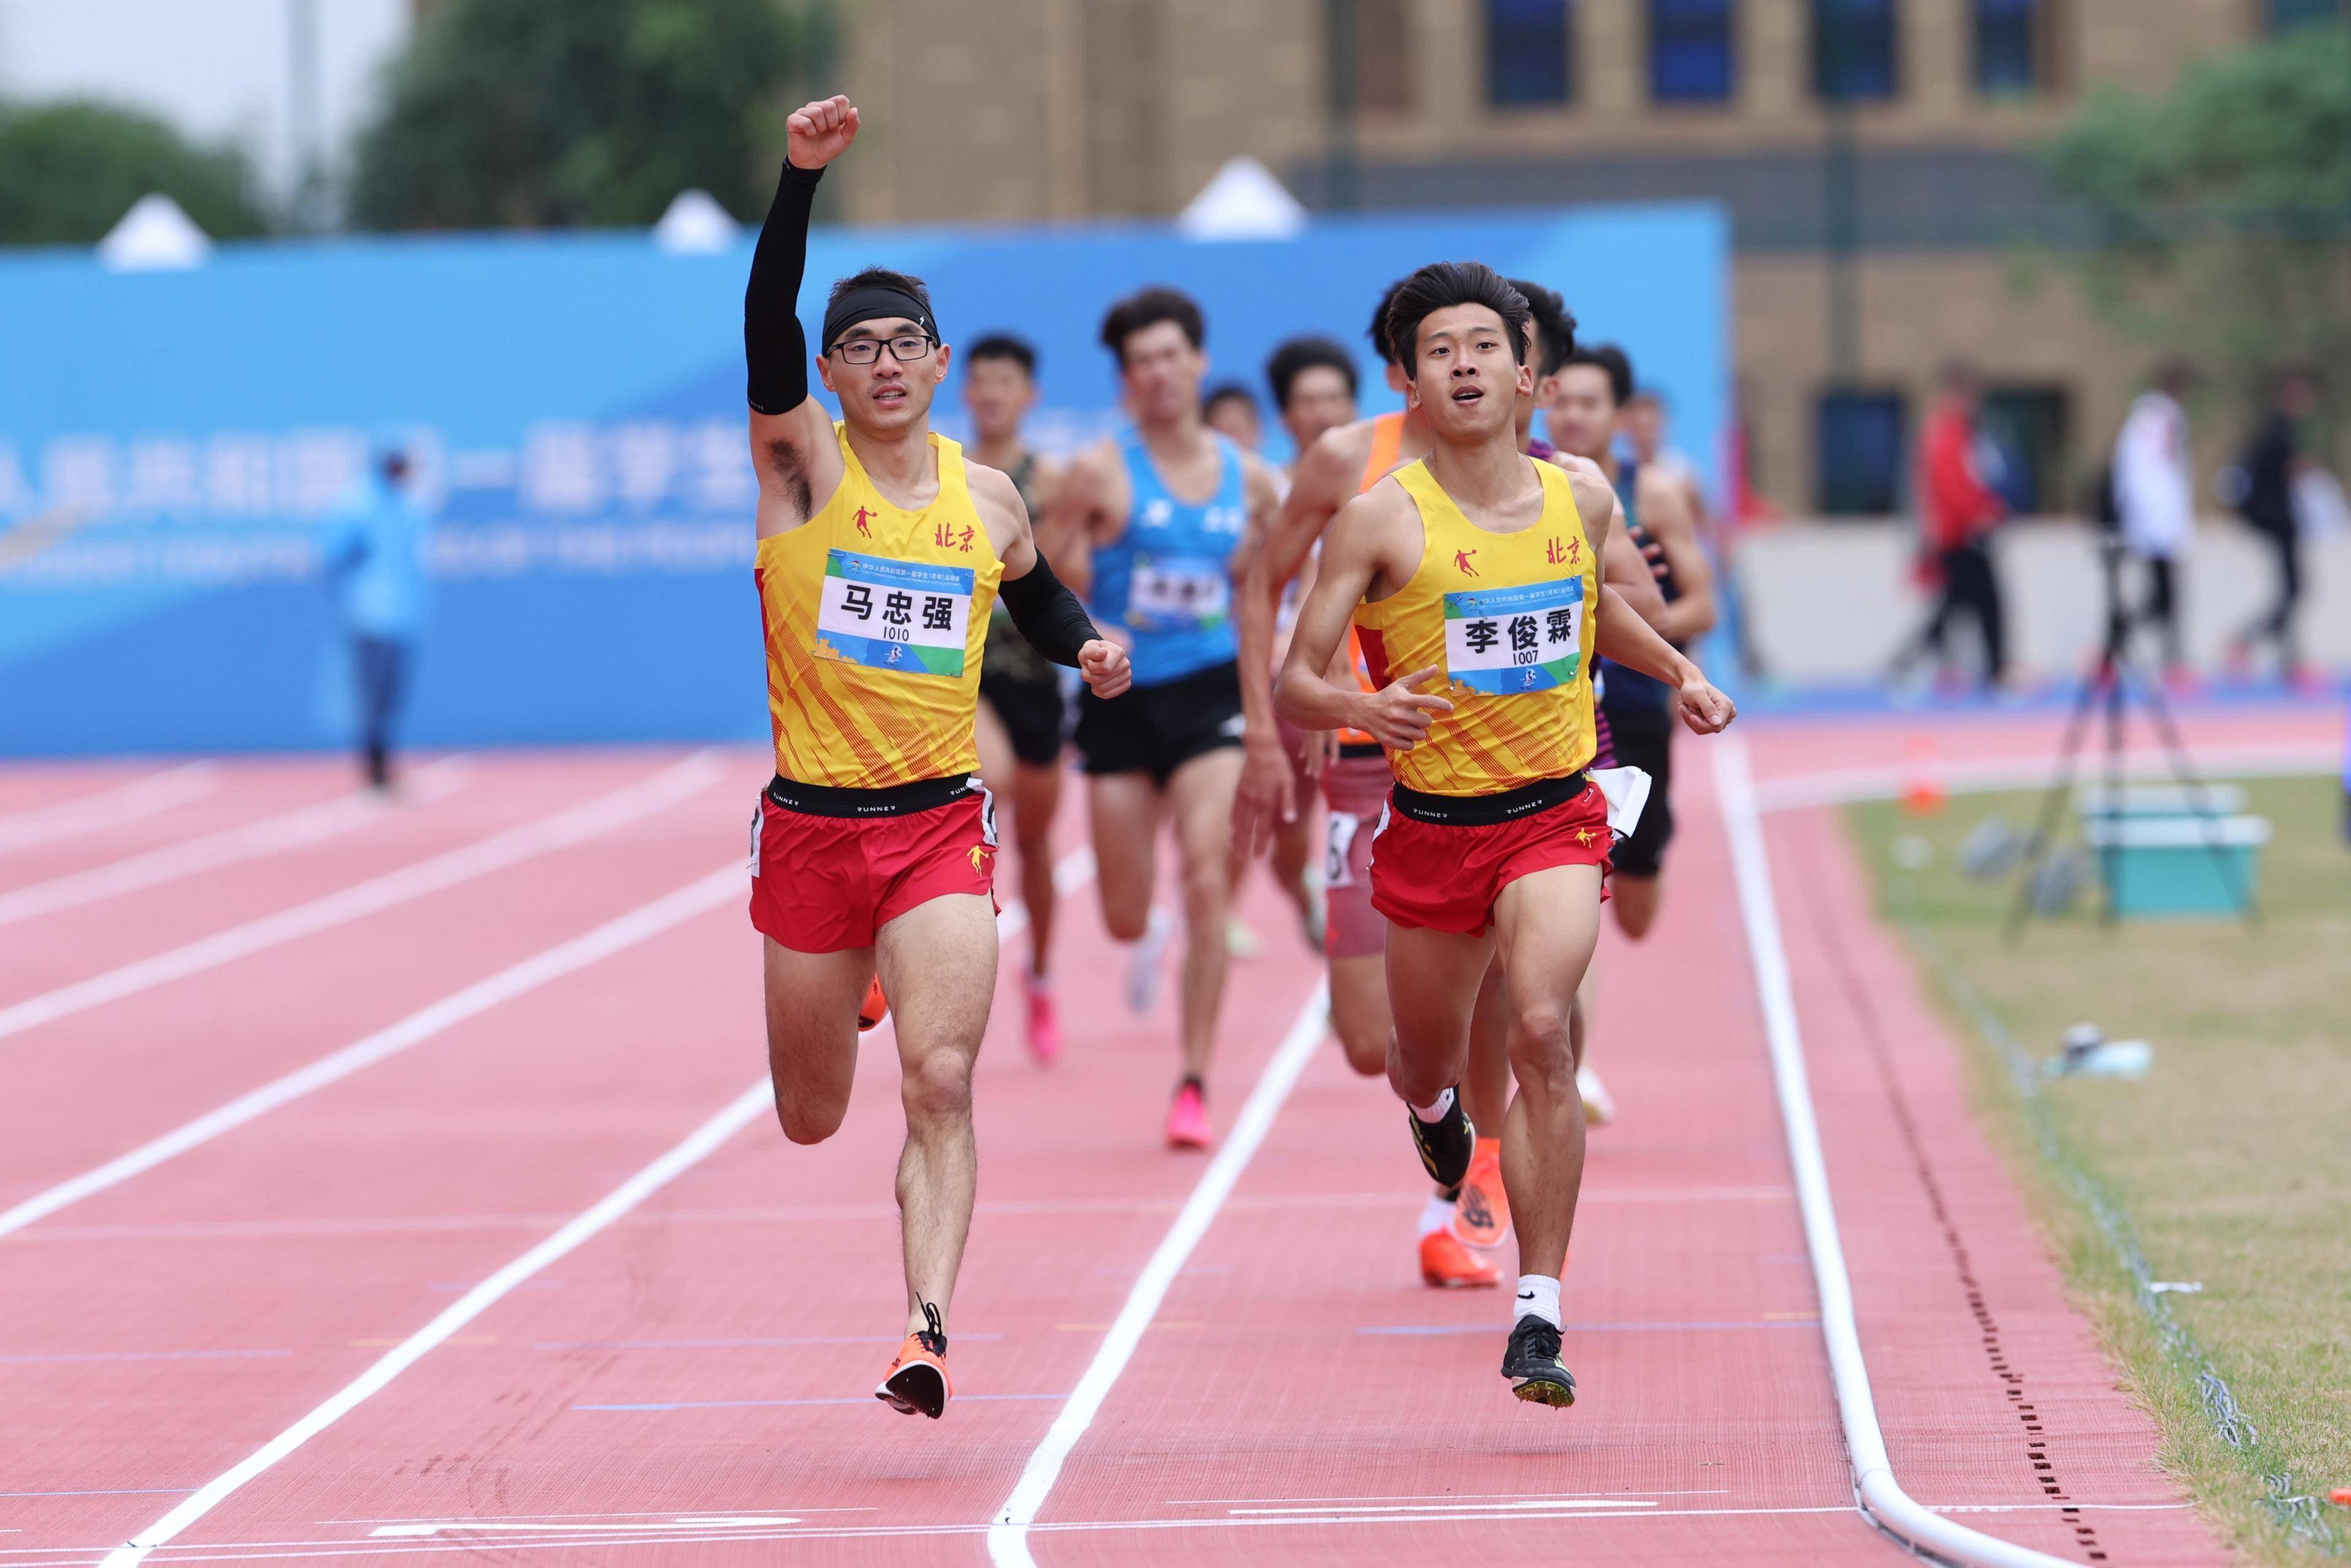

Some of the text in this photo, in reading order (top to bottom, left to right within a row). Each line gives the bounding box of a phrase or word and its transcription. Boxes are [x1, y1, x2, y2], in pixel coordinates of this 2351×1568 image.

[934, 522, 975, 553] 北京
[1546, 535, 1580, 565] 北京
[840, 584, 953, 631] 马忠强
[883, 625, 910, 641] 1010
[1465, 608, 1571, 654] 李俊霖
[1513, 650, 1538, 665] 1007
[1413, 808, 1448, 819] RUNNER
[1506, 799, 1543, 814] RUNNER
